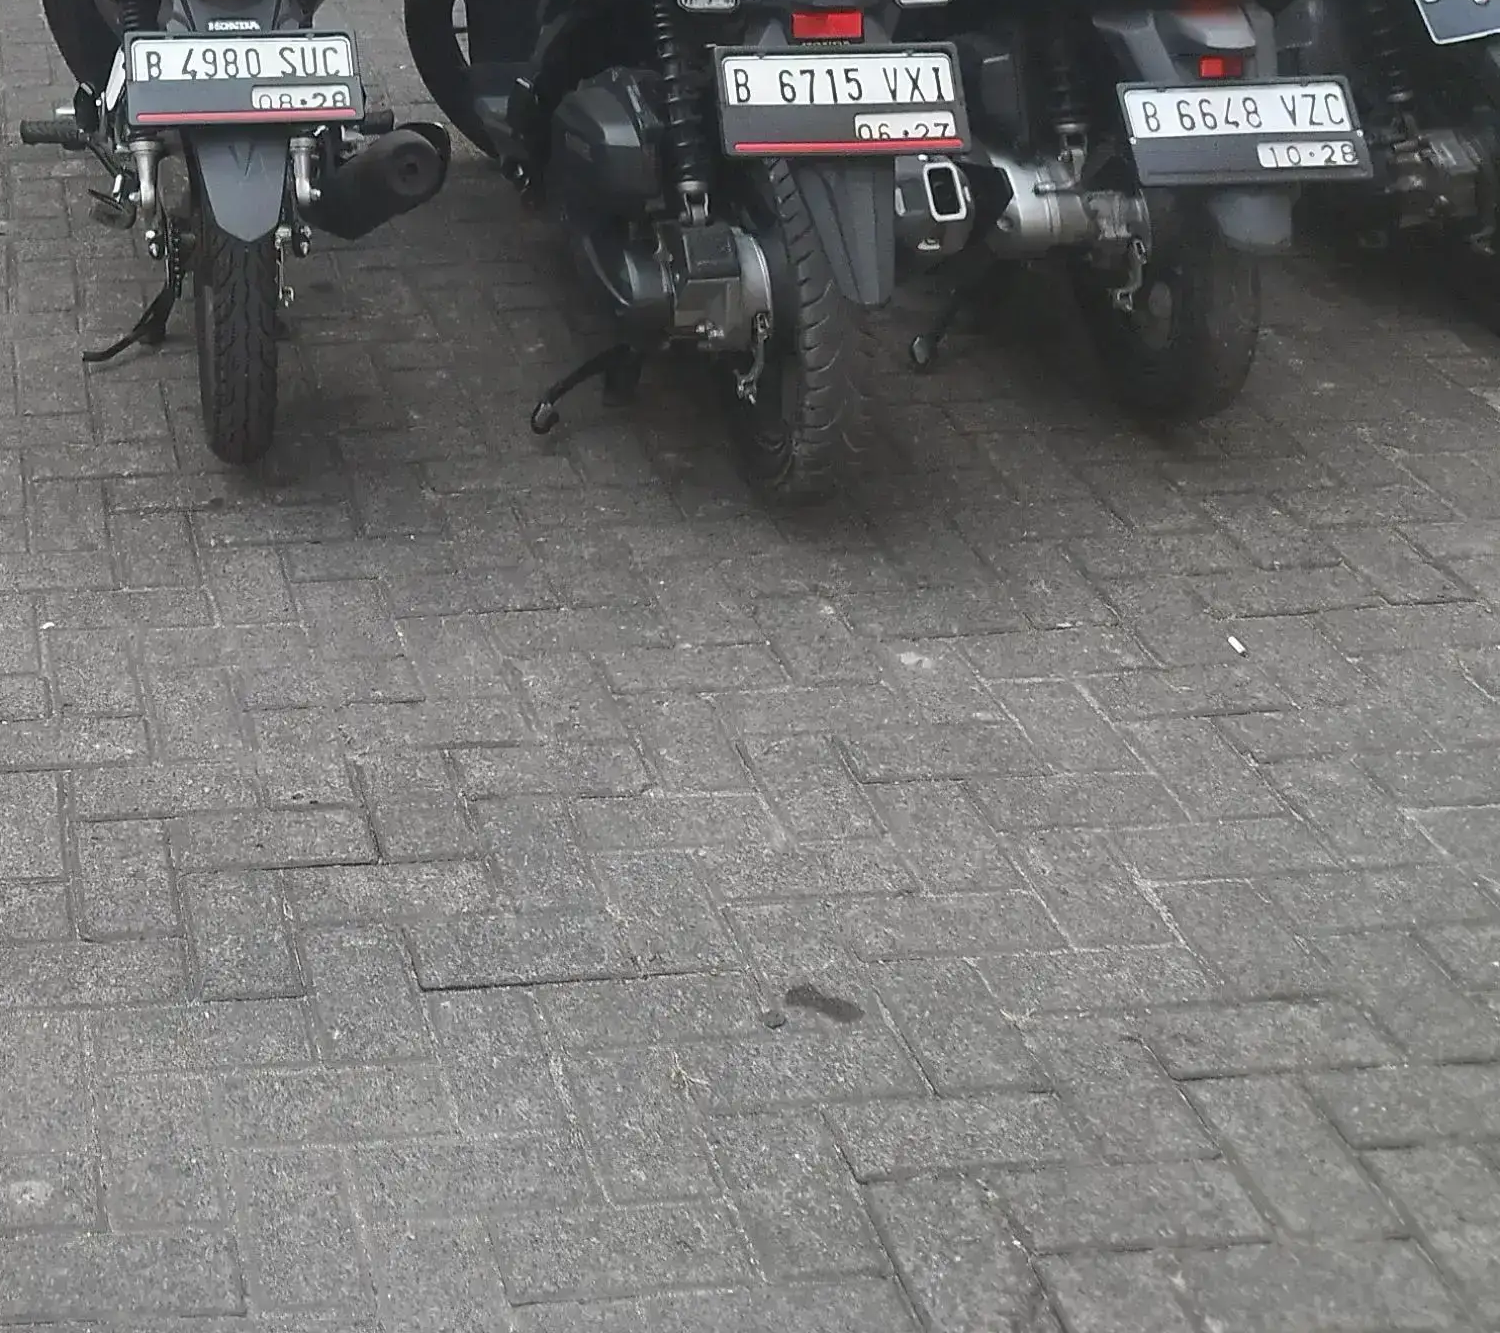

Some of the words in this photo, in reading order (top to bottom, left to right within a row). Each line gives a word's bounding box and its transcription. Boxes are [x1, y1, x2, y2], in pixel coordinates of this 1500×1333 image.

[208, 20, 261, 31] HONDA
[146, 51, 162, 79] B
[181, 48, 261, 80] 4980
[279, 46, 340, 78] SUC
[733, 68, 751, 103] B
[778, 68, 863, 104] 6715
[882, 67, 946, 102] VXI
[1141, 100, 1161, 132] B
[1176, 97, 1262, 131] 6648
[1280, 93, 1345, 127] VZC
